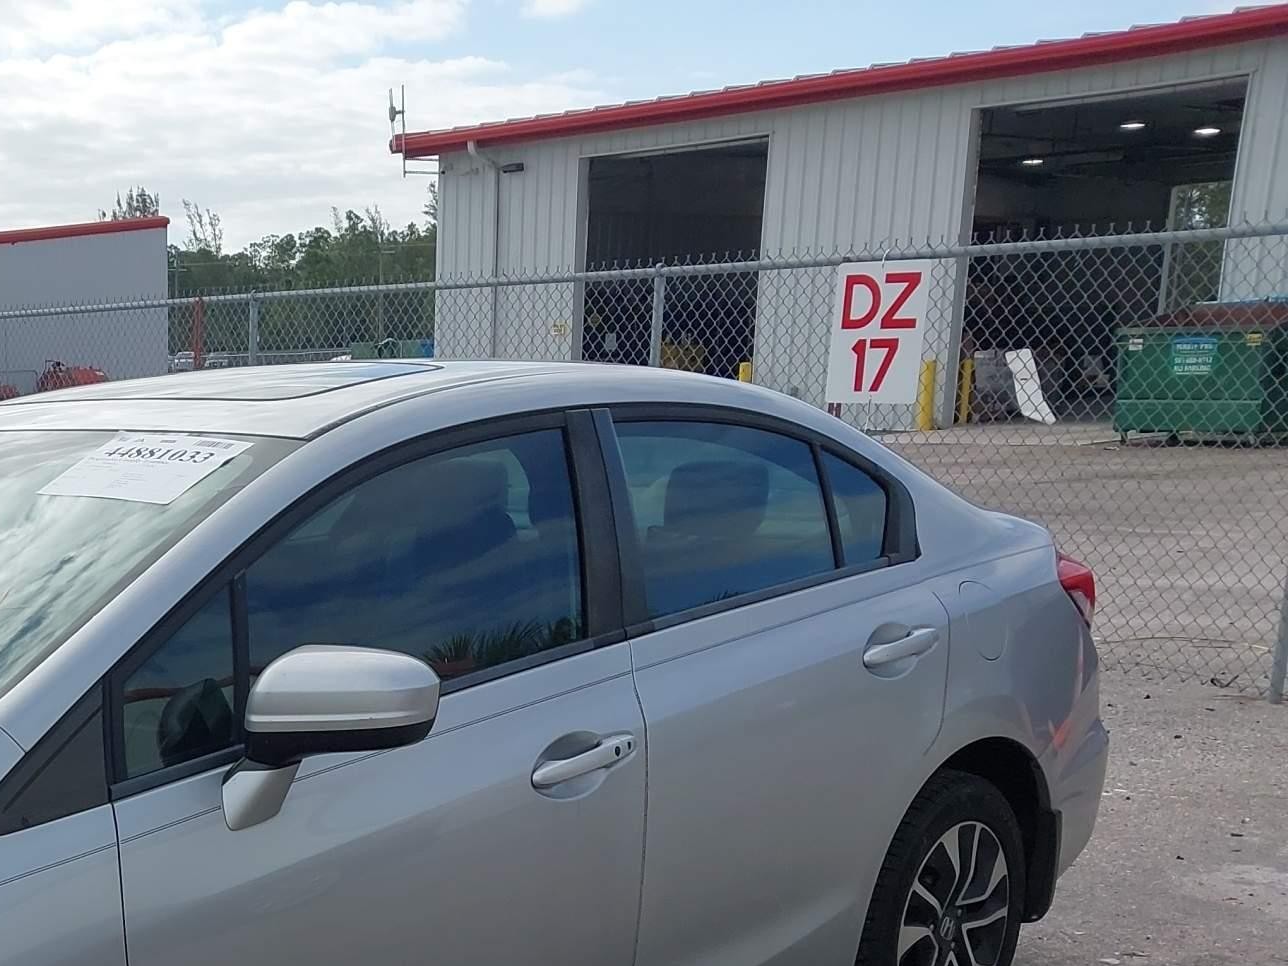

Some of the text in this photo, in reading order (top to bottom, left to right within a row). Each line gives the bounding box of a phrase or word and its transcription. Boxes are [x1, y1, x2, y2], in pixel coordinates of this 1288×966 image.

[840, 272, 922, 330] DZ
[851, 337, 900, 393] 17
[103, 446, 216, 464] 44881033
